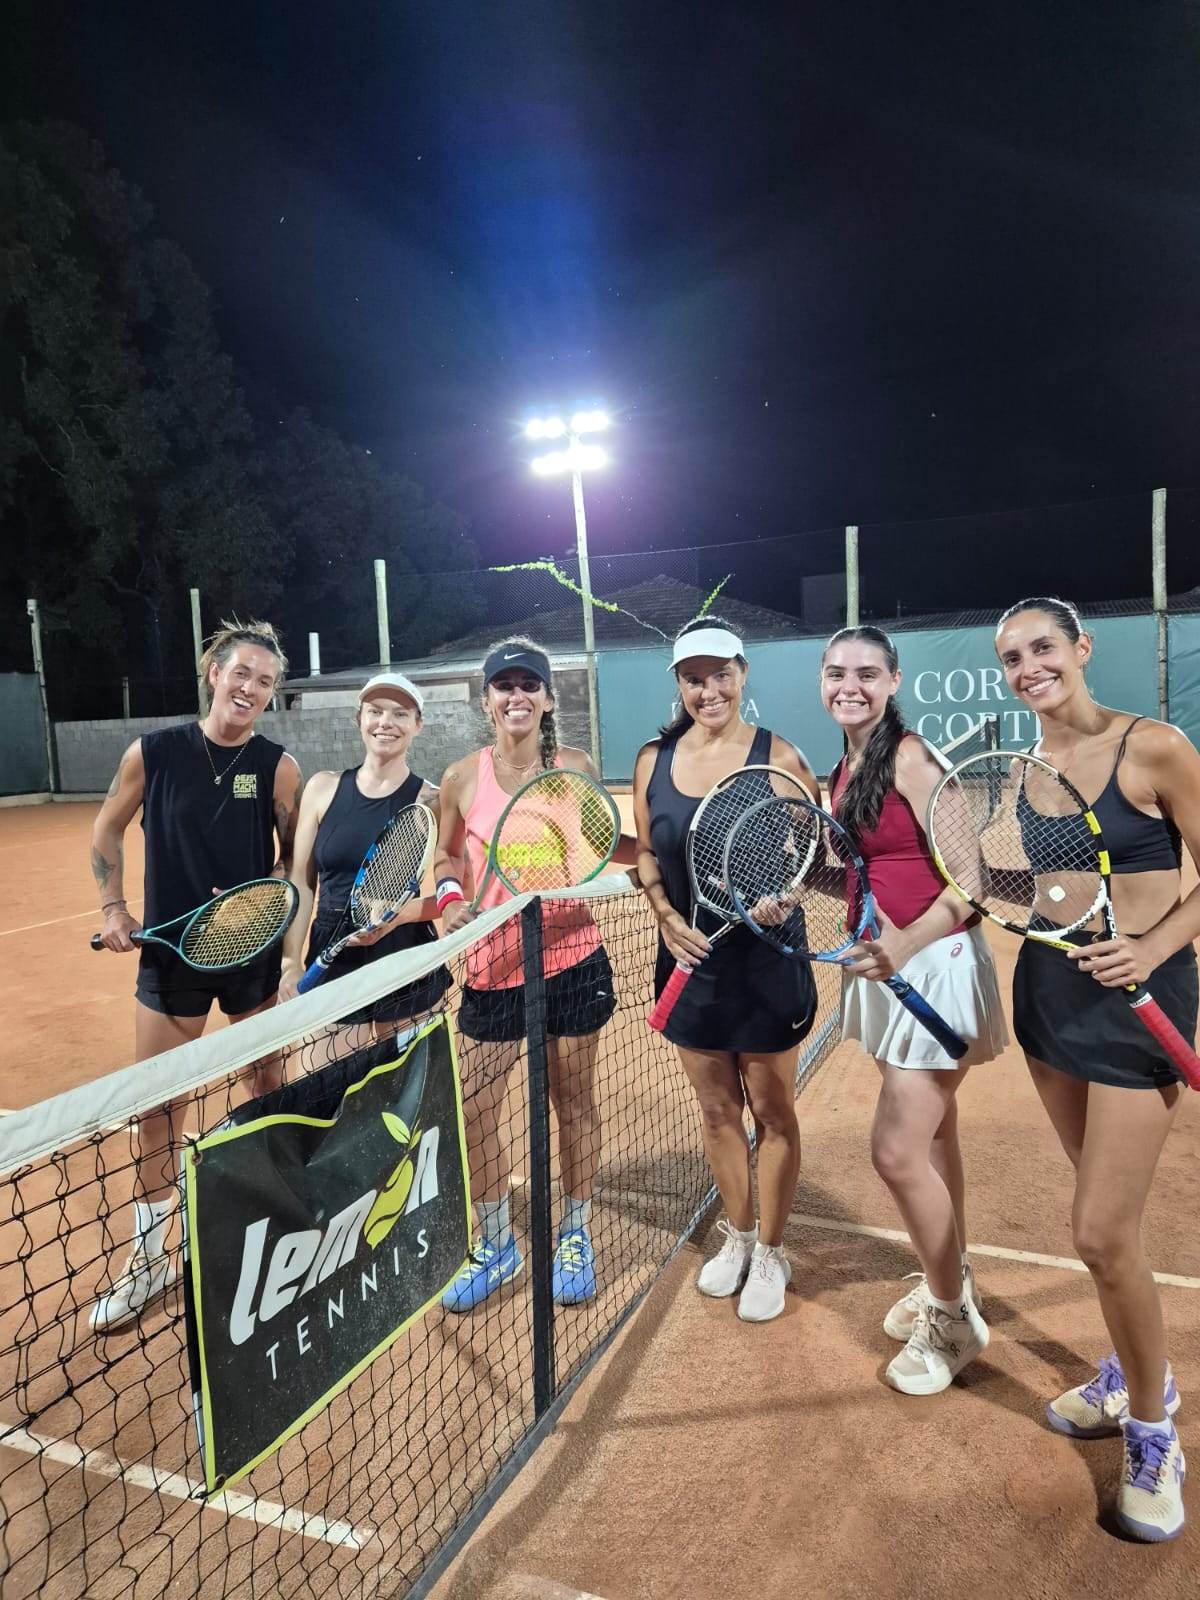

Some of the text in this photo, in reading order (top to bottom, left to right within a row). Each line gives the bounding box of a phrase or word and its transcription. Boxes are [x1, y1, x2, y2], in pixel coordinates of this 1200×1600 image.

[914, 667, 1019, 704] COR
[917, 710, 1043, 744] COTI
[265, 1228, 429, 1380] TENNIS
